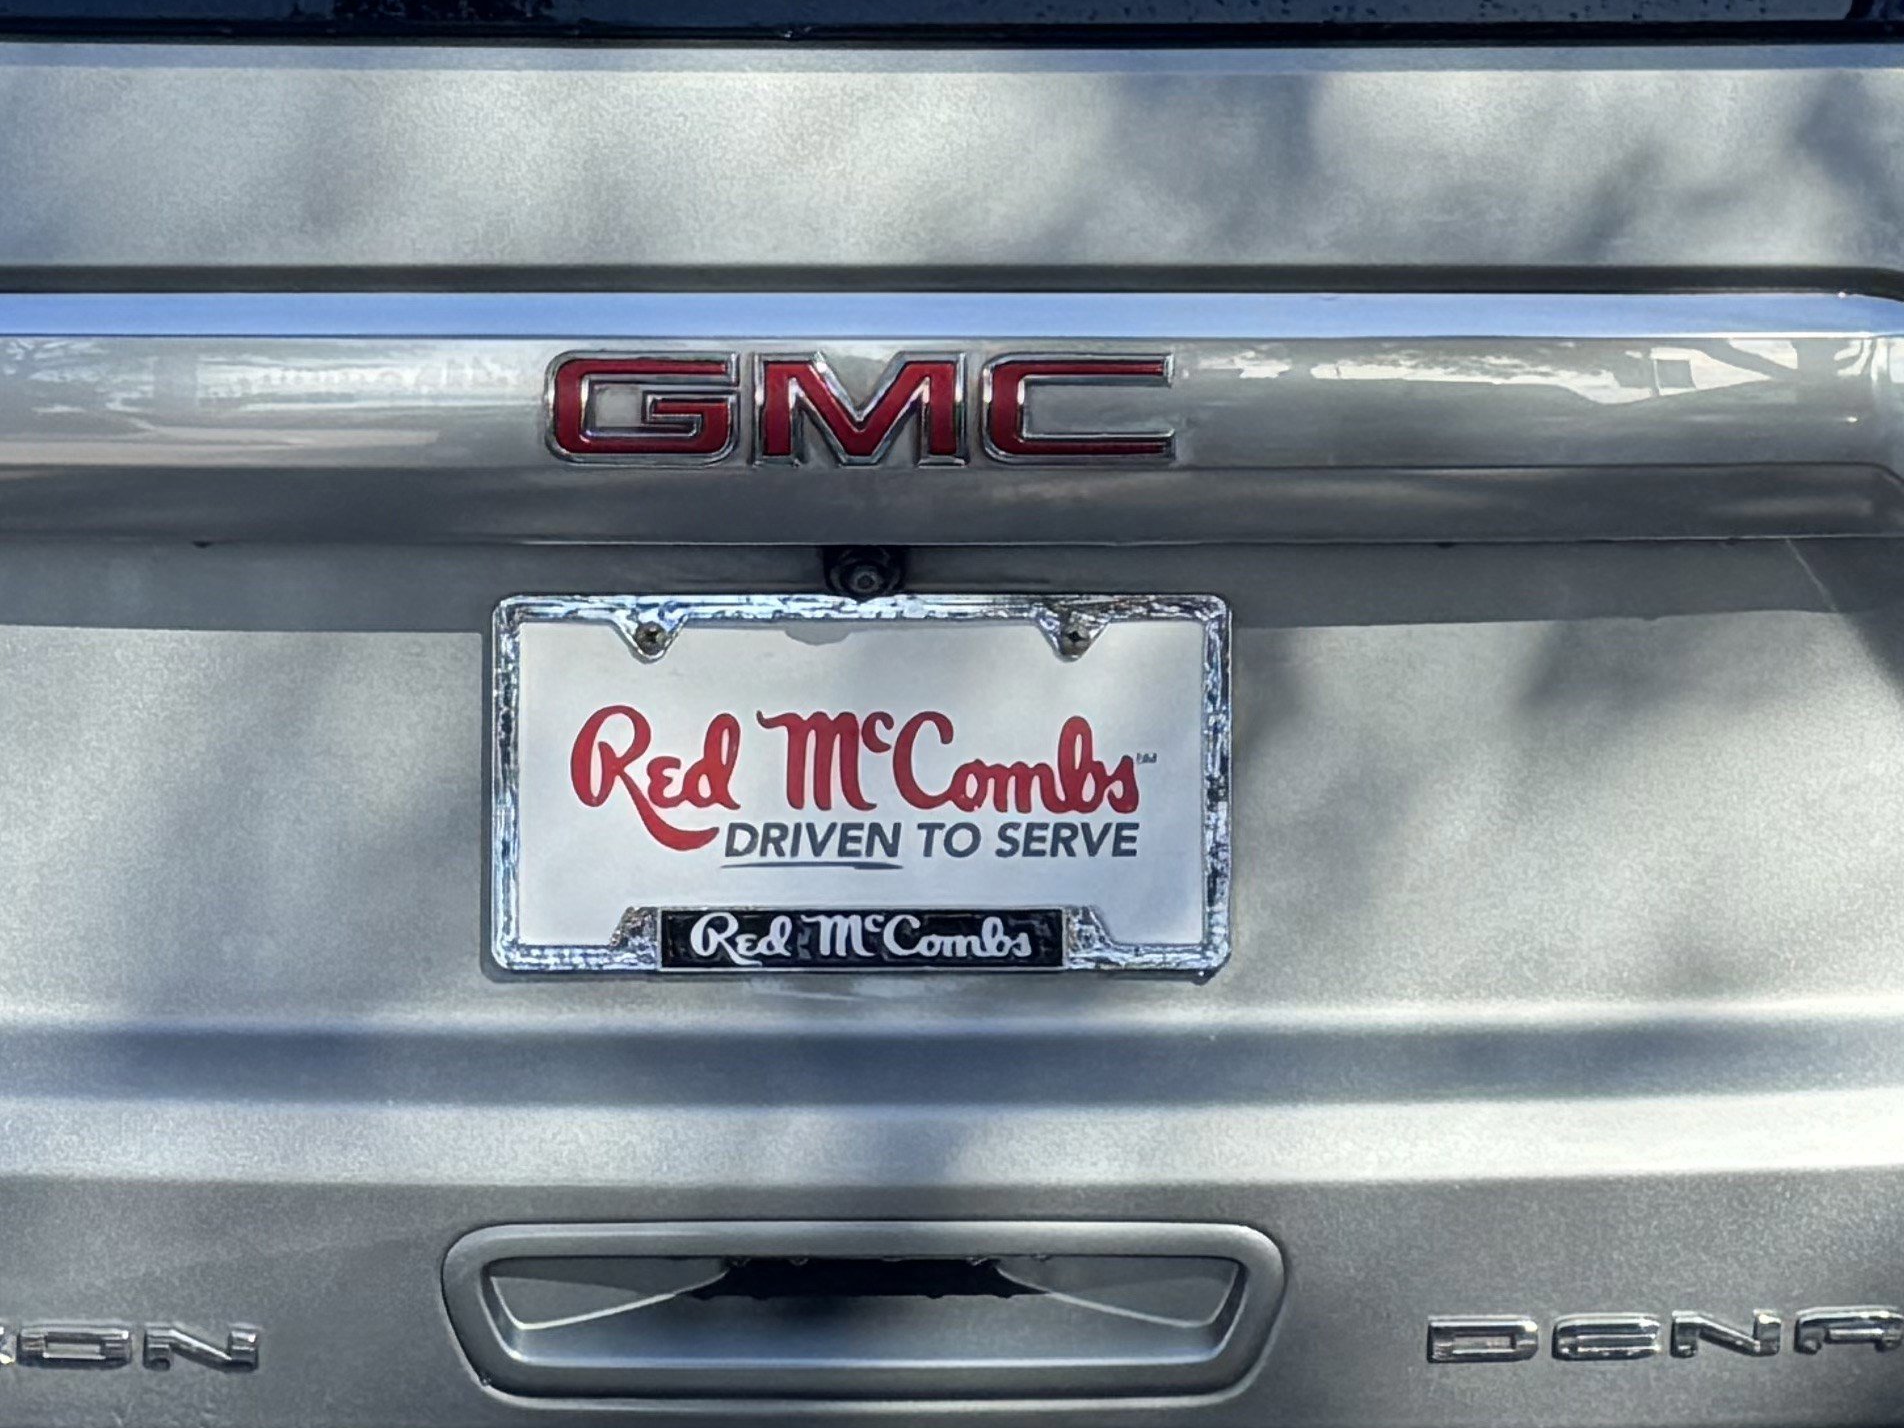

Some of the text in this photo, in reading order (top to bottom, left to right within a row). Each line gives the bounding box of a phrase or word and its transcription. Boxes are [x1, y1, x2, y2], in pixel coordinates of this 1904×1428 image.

[545, 350, 1177, 467] GMC
[570, 704, 1140, 850] Red McCombs
[724, 822, 1140, 859] DRIVEN TO SERVE
[690, 913, 1032, 958] Red McCombs
